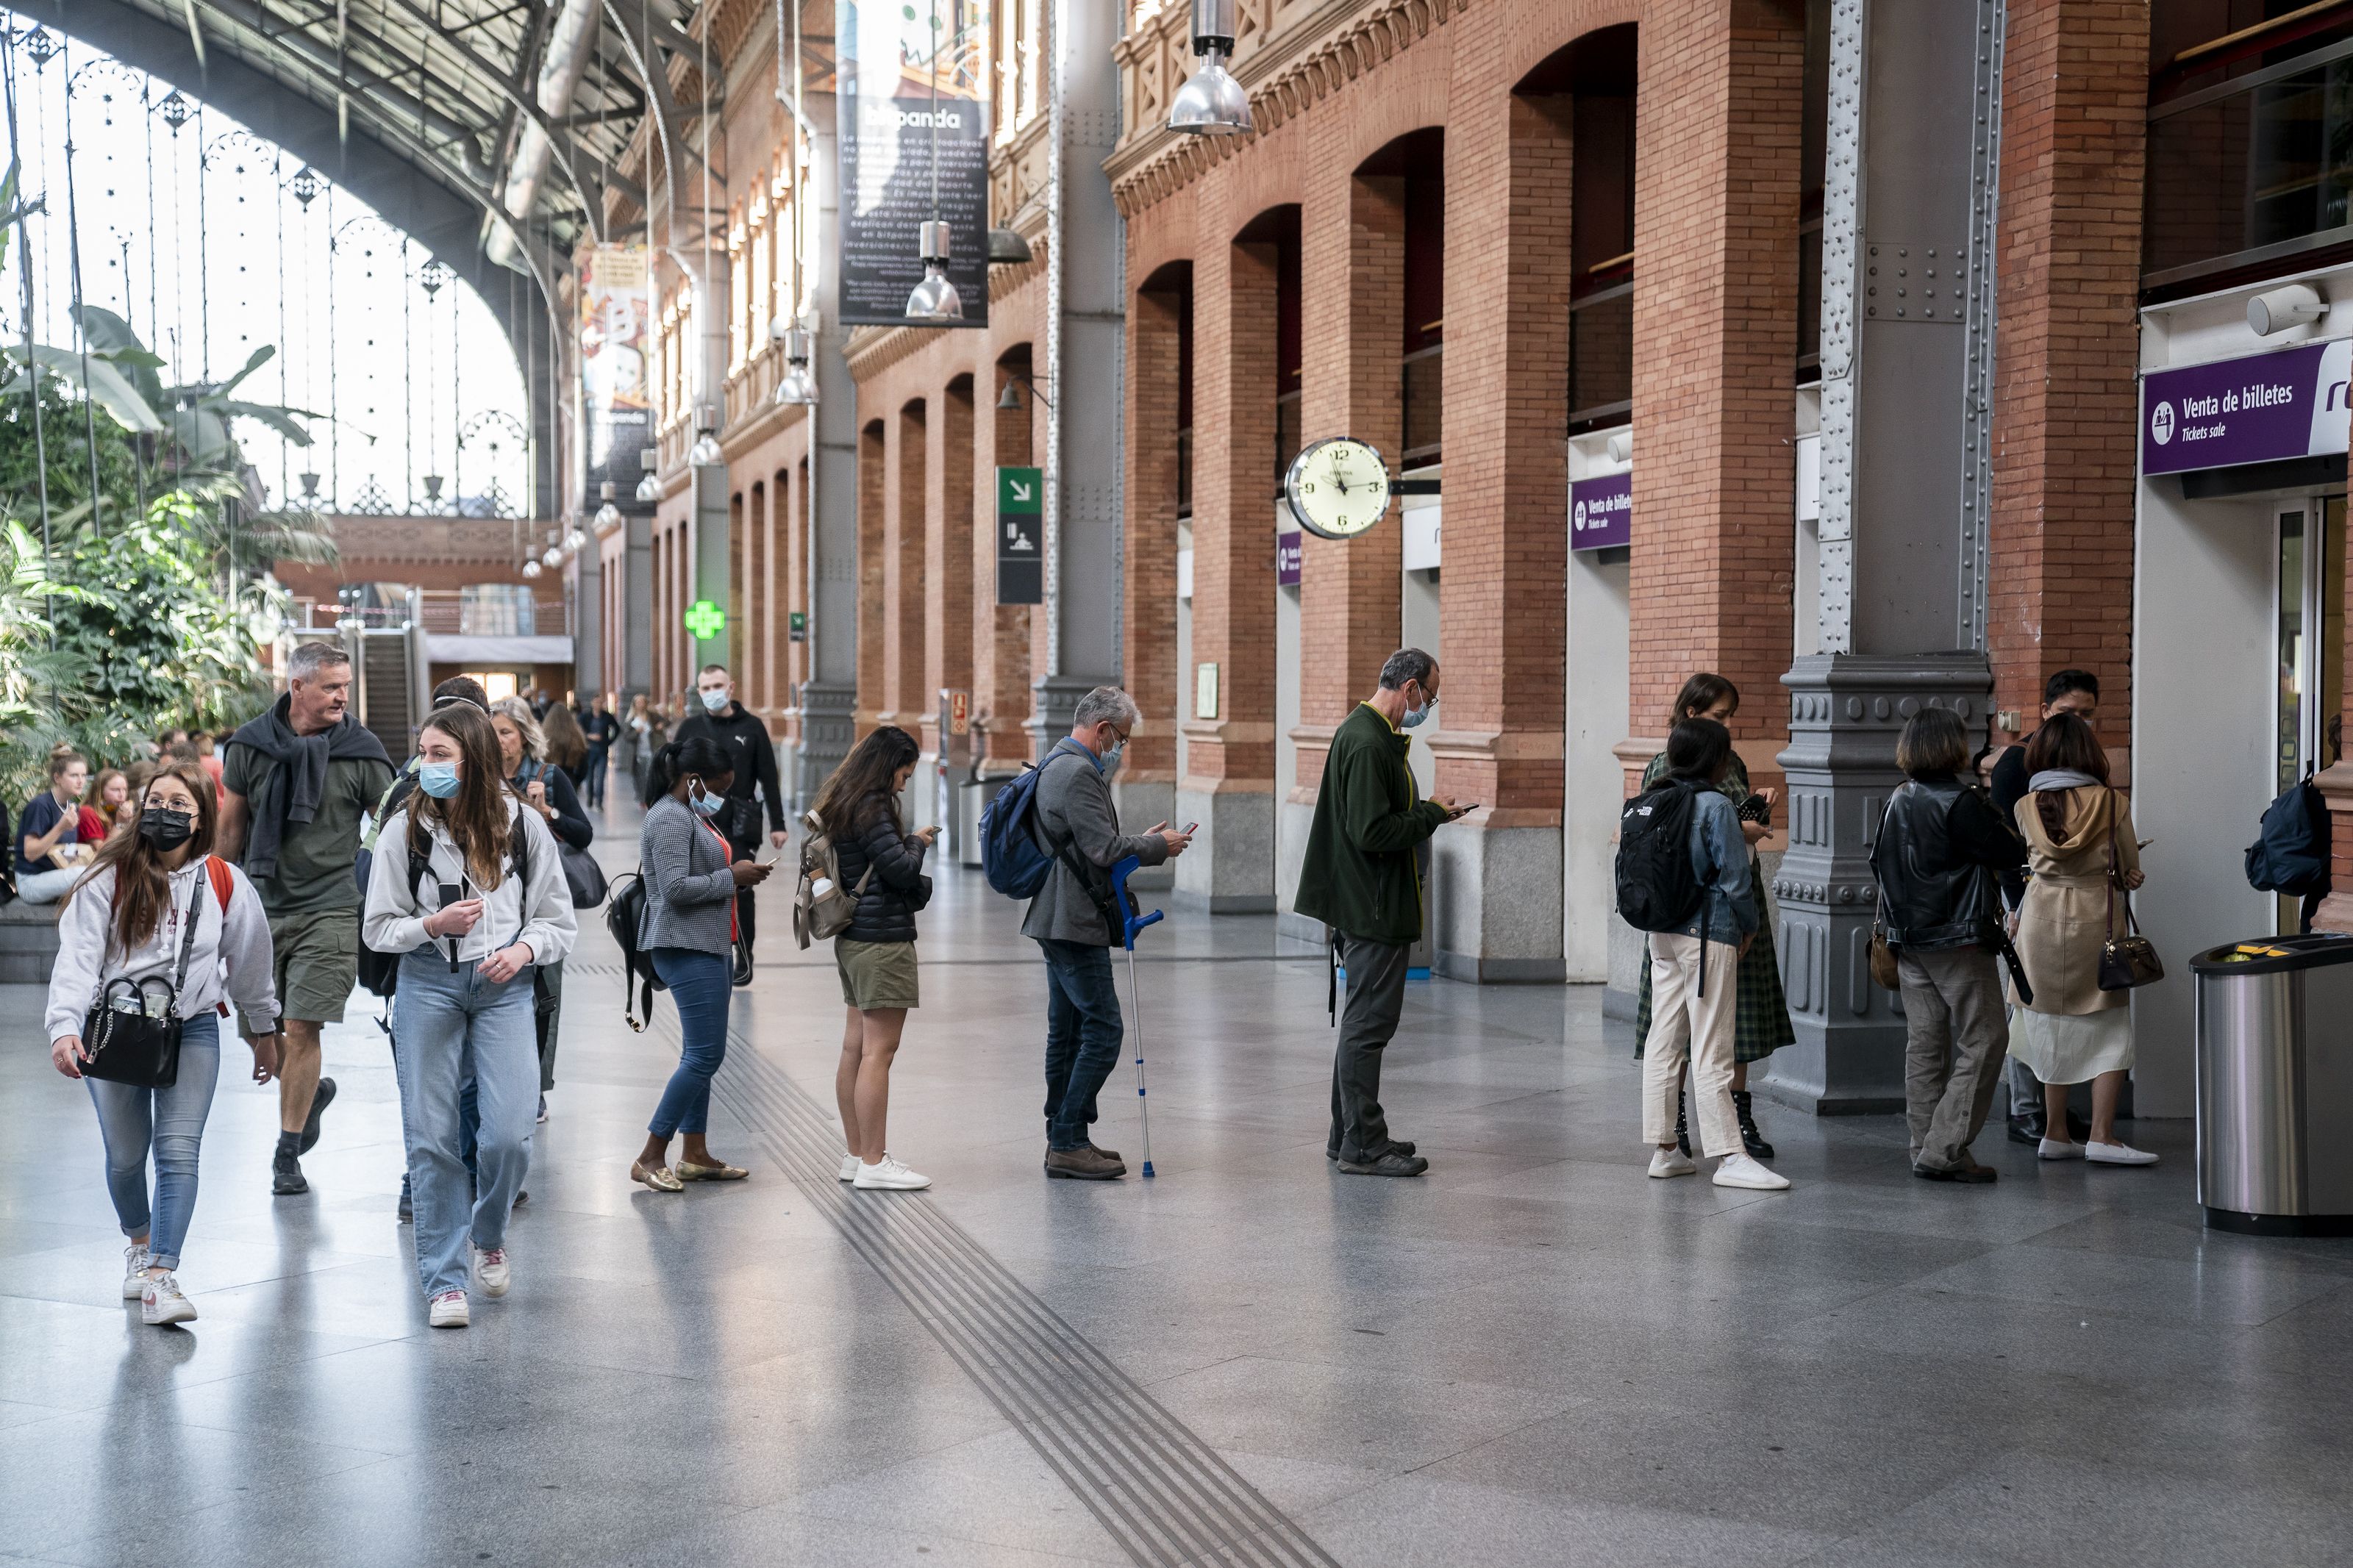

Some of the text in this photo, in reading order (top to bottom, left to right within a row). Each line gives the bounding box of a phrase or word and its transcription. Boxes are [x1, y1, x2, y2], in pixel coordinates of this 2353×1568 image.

[918, 137, 982, 148] critoactivos
[923, 170, 967, 178] pederse
[938, 181, 973, 189] mporte
[907, 189, 960, 198] impoante
[2183, 384, 2293, 419] Venta de billetes
[2182, 422, 2226, 442] Tickets sale
[1334, 450, 1349, 460] 12
[1306, 483, 1314, 494] 9
[1368, 482, 1379, 493] 3
[1588, 499, 1605, 515] Venta
[1606, 495, 1613, 512] de
[1338, 515, 1347, 526] 6
